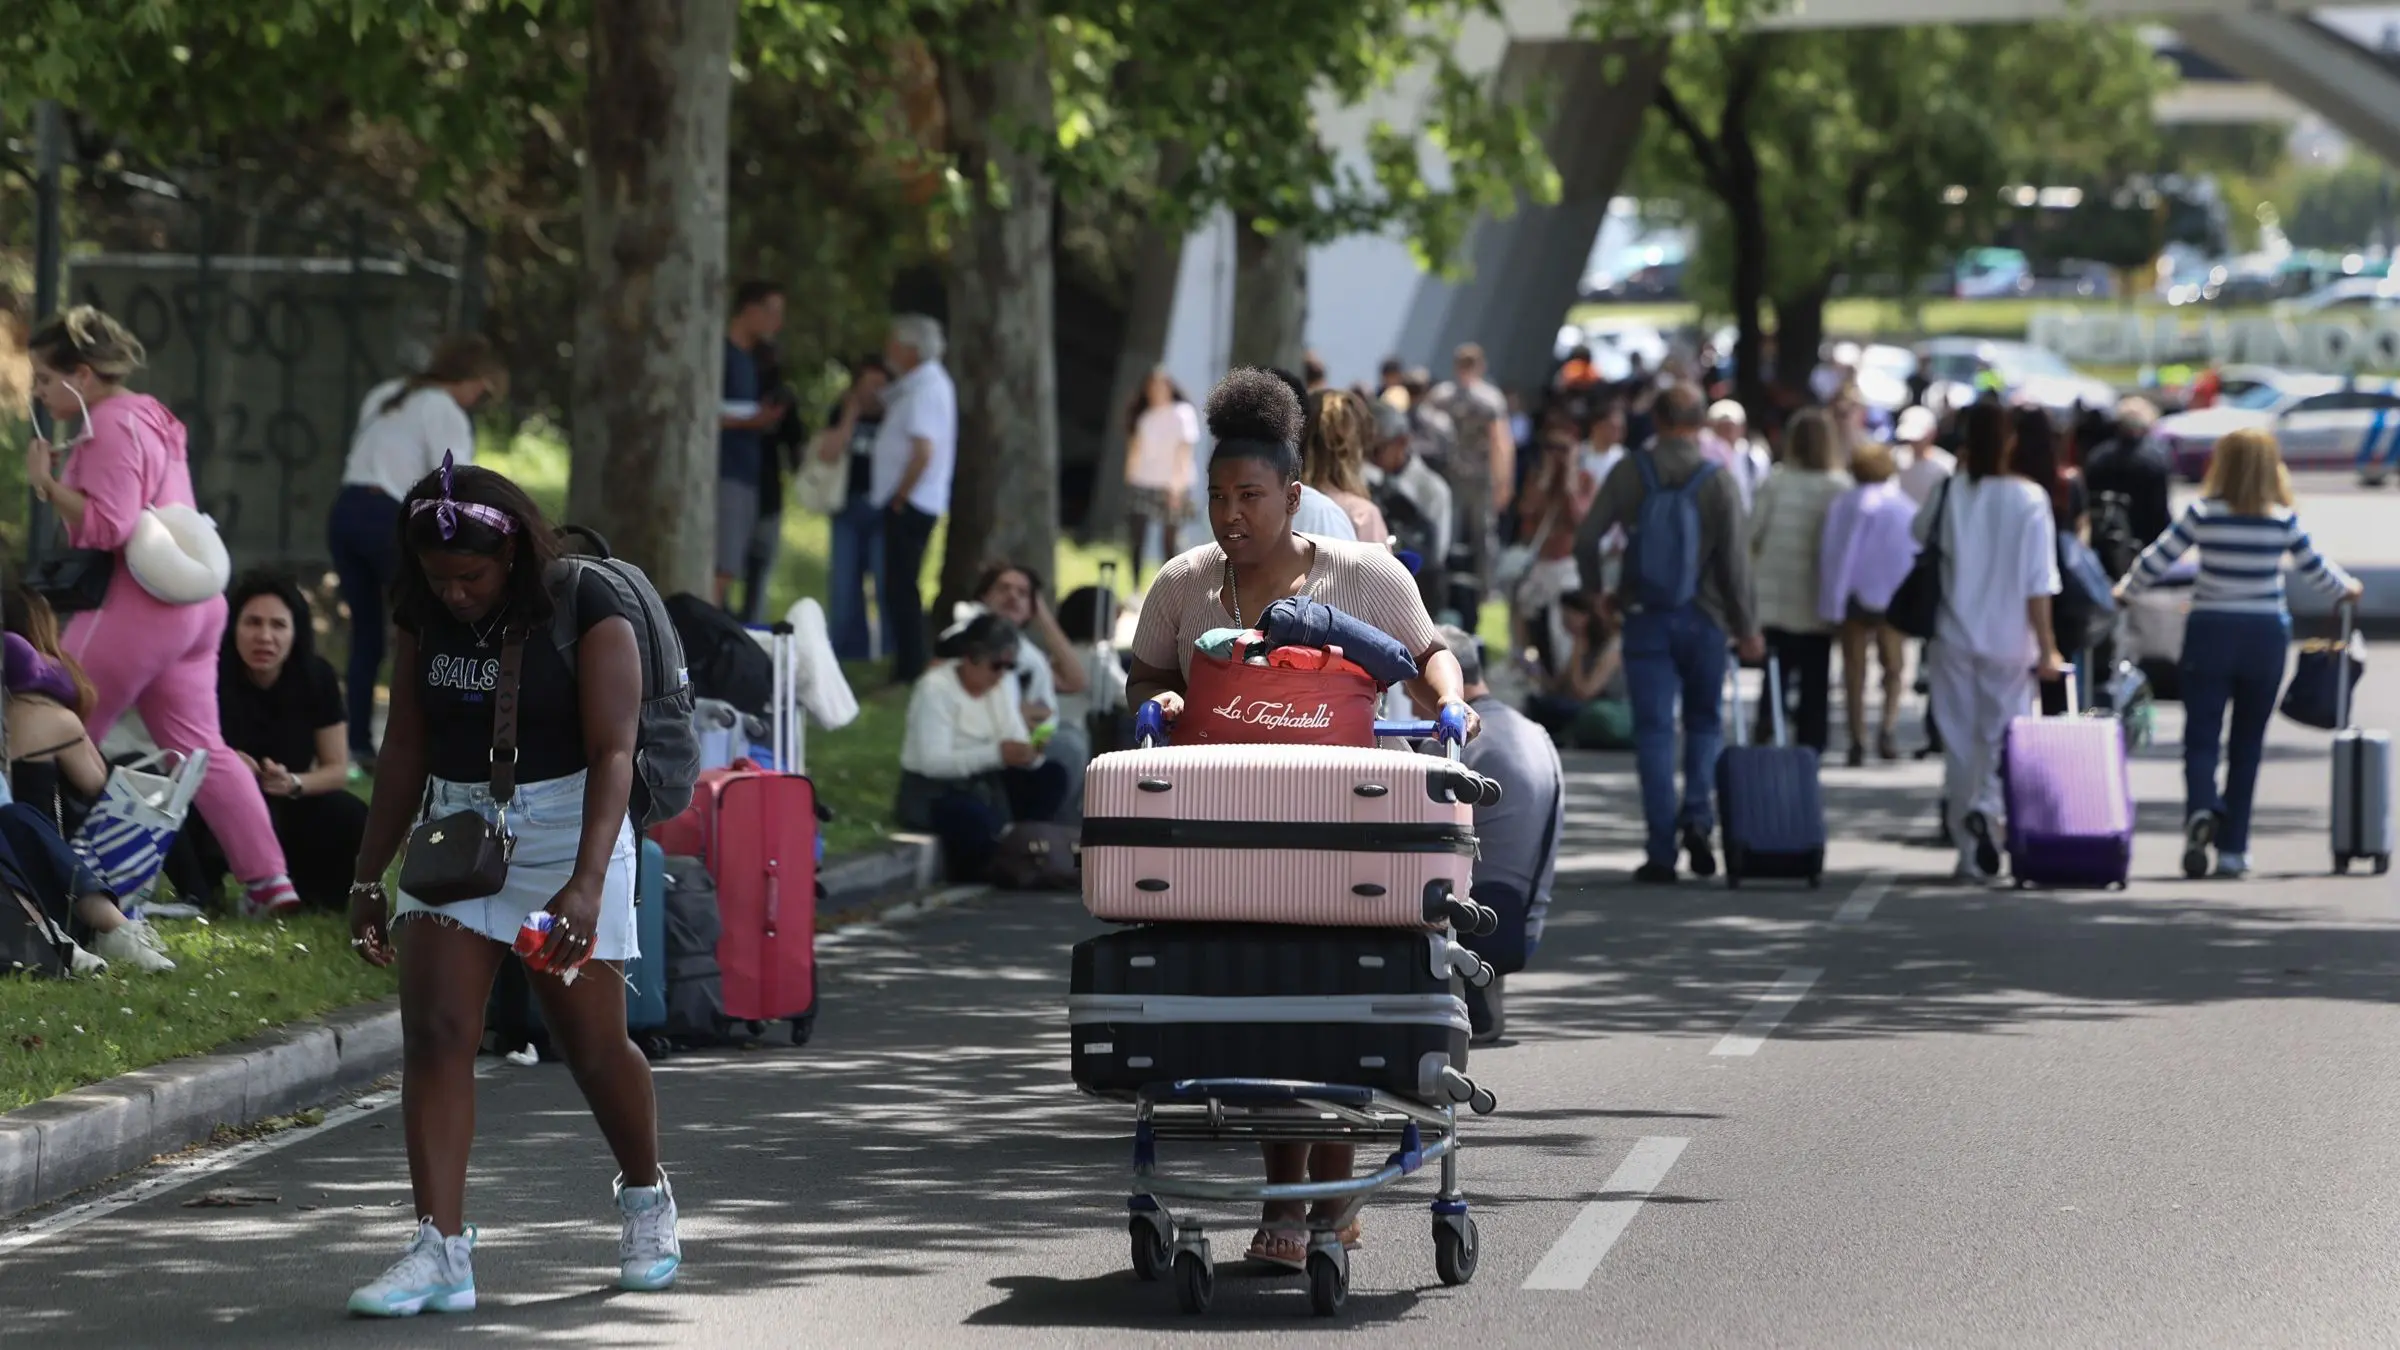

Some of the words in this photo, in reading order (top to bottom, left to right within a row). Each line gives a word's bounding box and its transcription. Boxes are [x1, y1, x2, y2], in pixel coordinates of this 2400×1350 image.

[428, 654, 503, 691] SALS
[1213, 695, 1242, 719] La
[1242, 701, 1330, 730] Tagliatella
